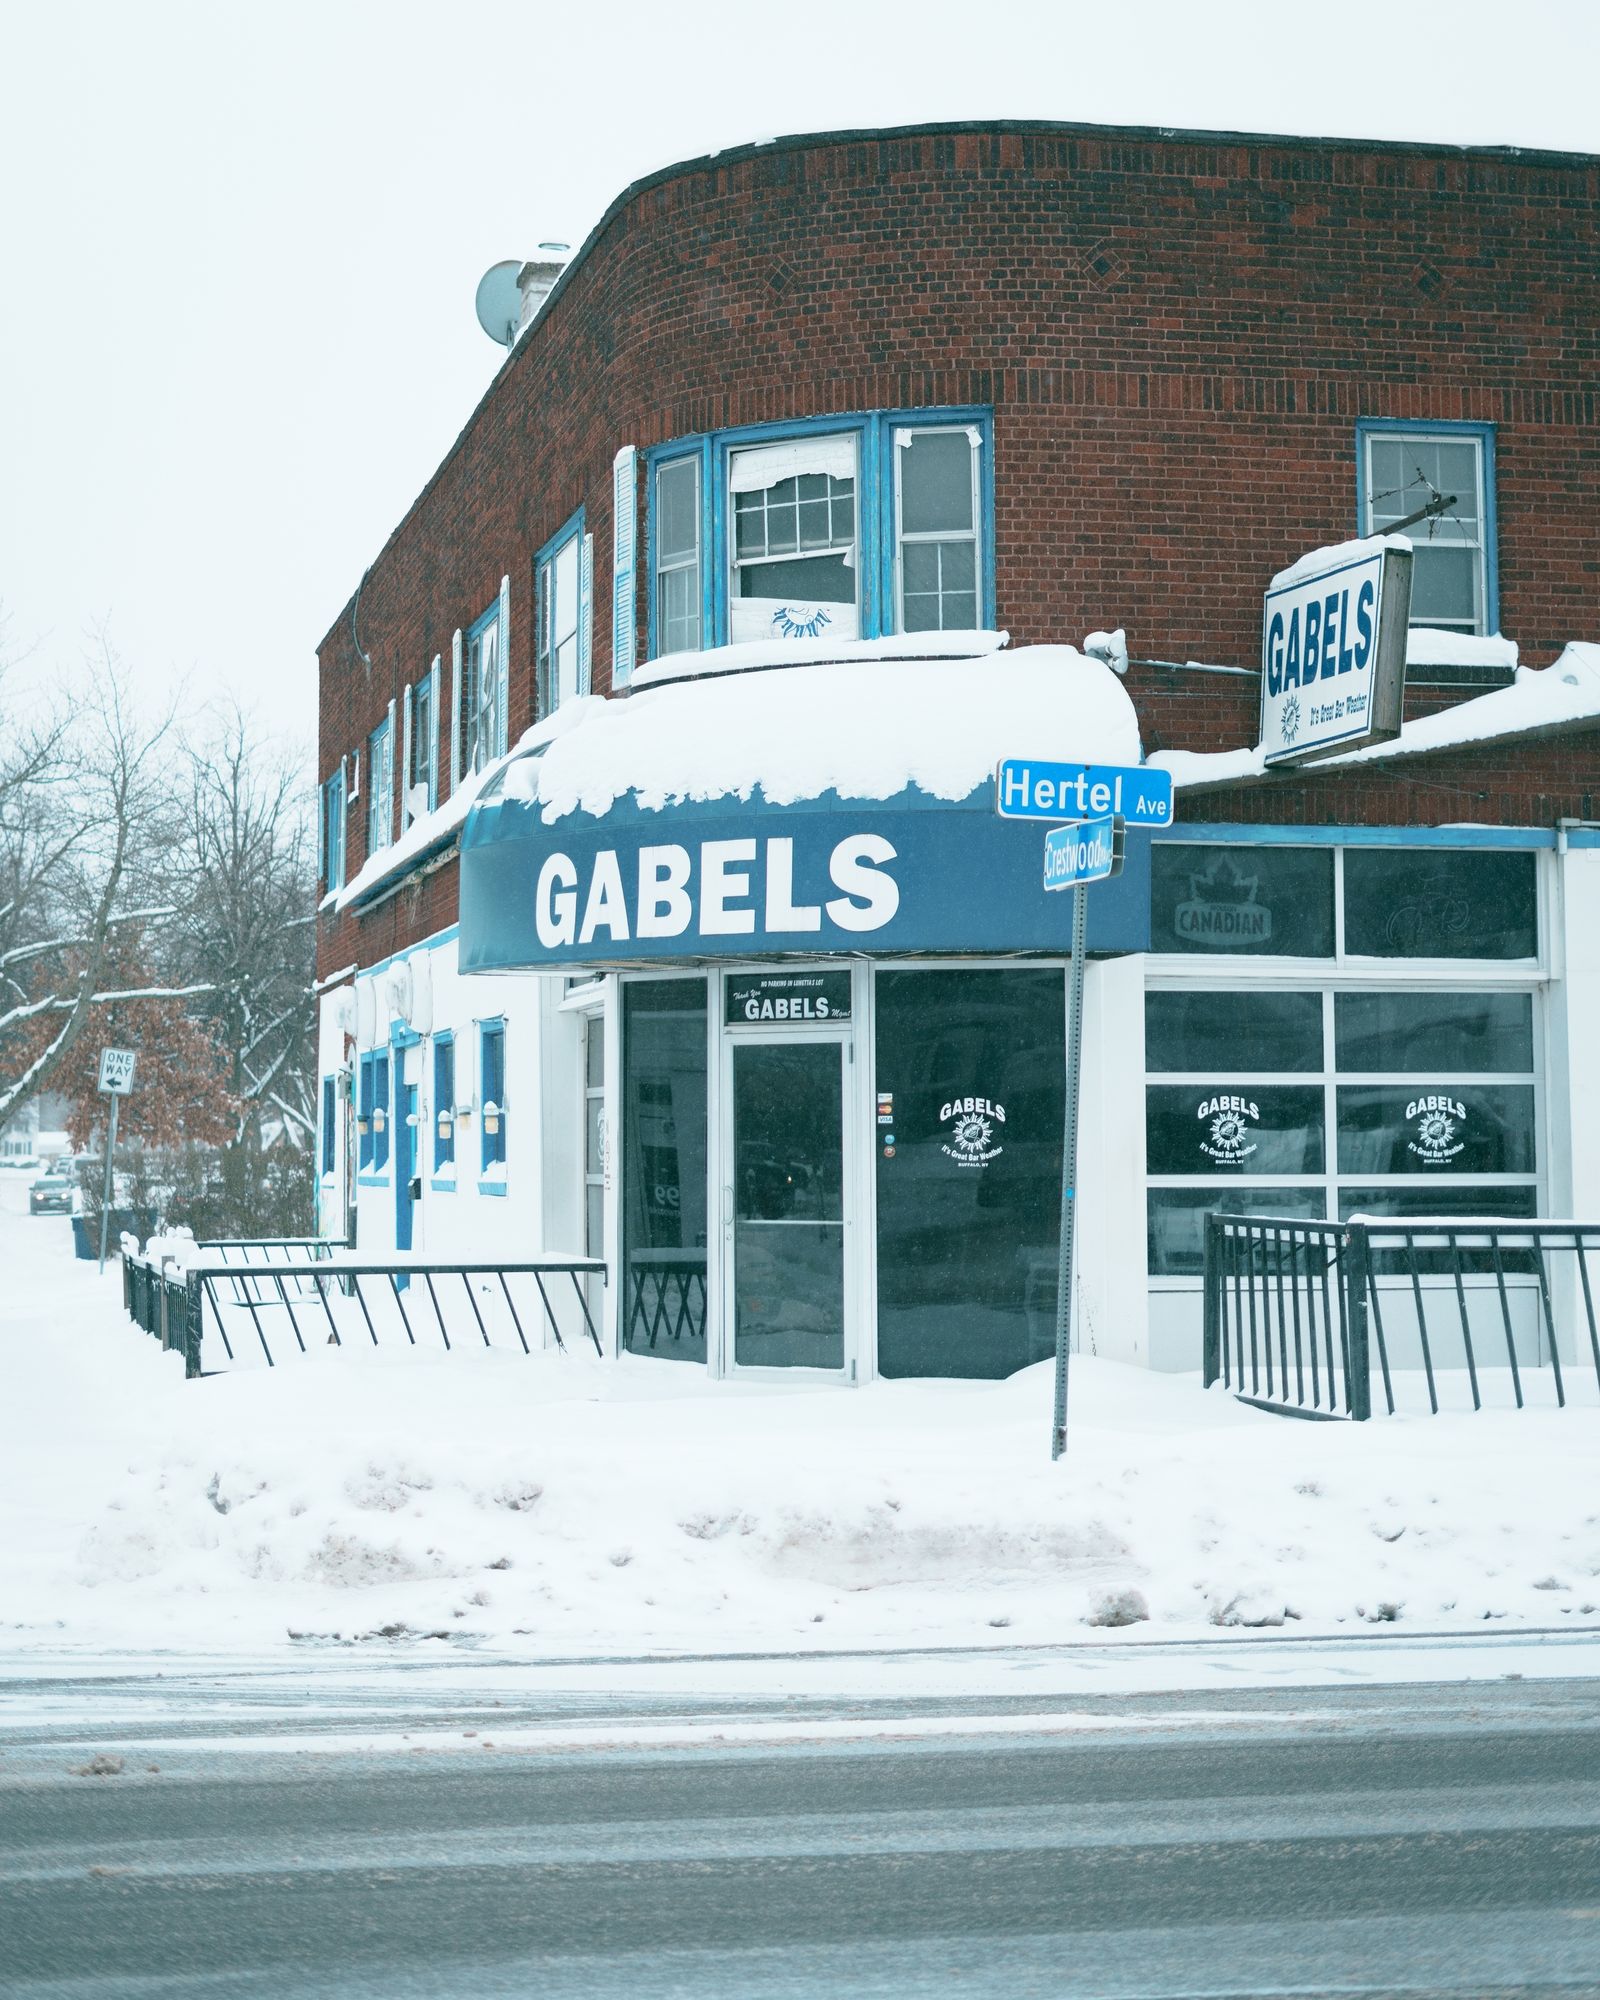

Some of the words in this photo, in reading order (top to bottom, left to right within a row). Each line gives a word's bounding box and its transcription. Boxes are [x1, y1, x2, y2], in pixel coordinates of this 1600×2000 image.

[1268, 580, 1374, 697] GABELS
[1005, 768, 1123, 813] Hertel
[1136, 795, 1167, 816] Ave
[1046, 830, 1102, 879] Crestwood
[536, 833, 900, 949] GABELS
[1180, 910, 1264, 935] CANADIAN
[733, 991, 749, 1000] Thank
[750, 989, 761, 999] You
[768, 980, 787, 988] PARKING
[816, 979, 824, 987] LOT
[745, 997, 829, 1020] GABELS
[106, 1063, 131, 1077] WAY
[108, 1052, 132, 1065] ONE
[939, 1097, 1006, 1122] GABELS
[1198, 1096, 1260, 1120] GABELS
[1406, 1096, 1466, 1120] GABELS
[941, 1144, 951, 1155] It's
[951, 1150, 968, 1161] Great
[968, 1153, 979, 1161] Bar
[979, 1146, 1004, 1160] Weather
